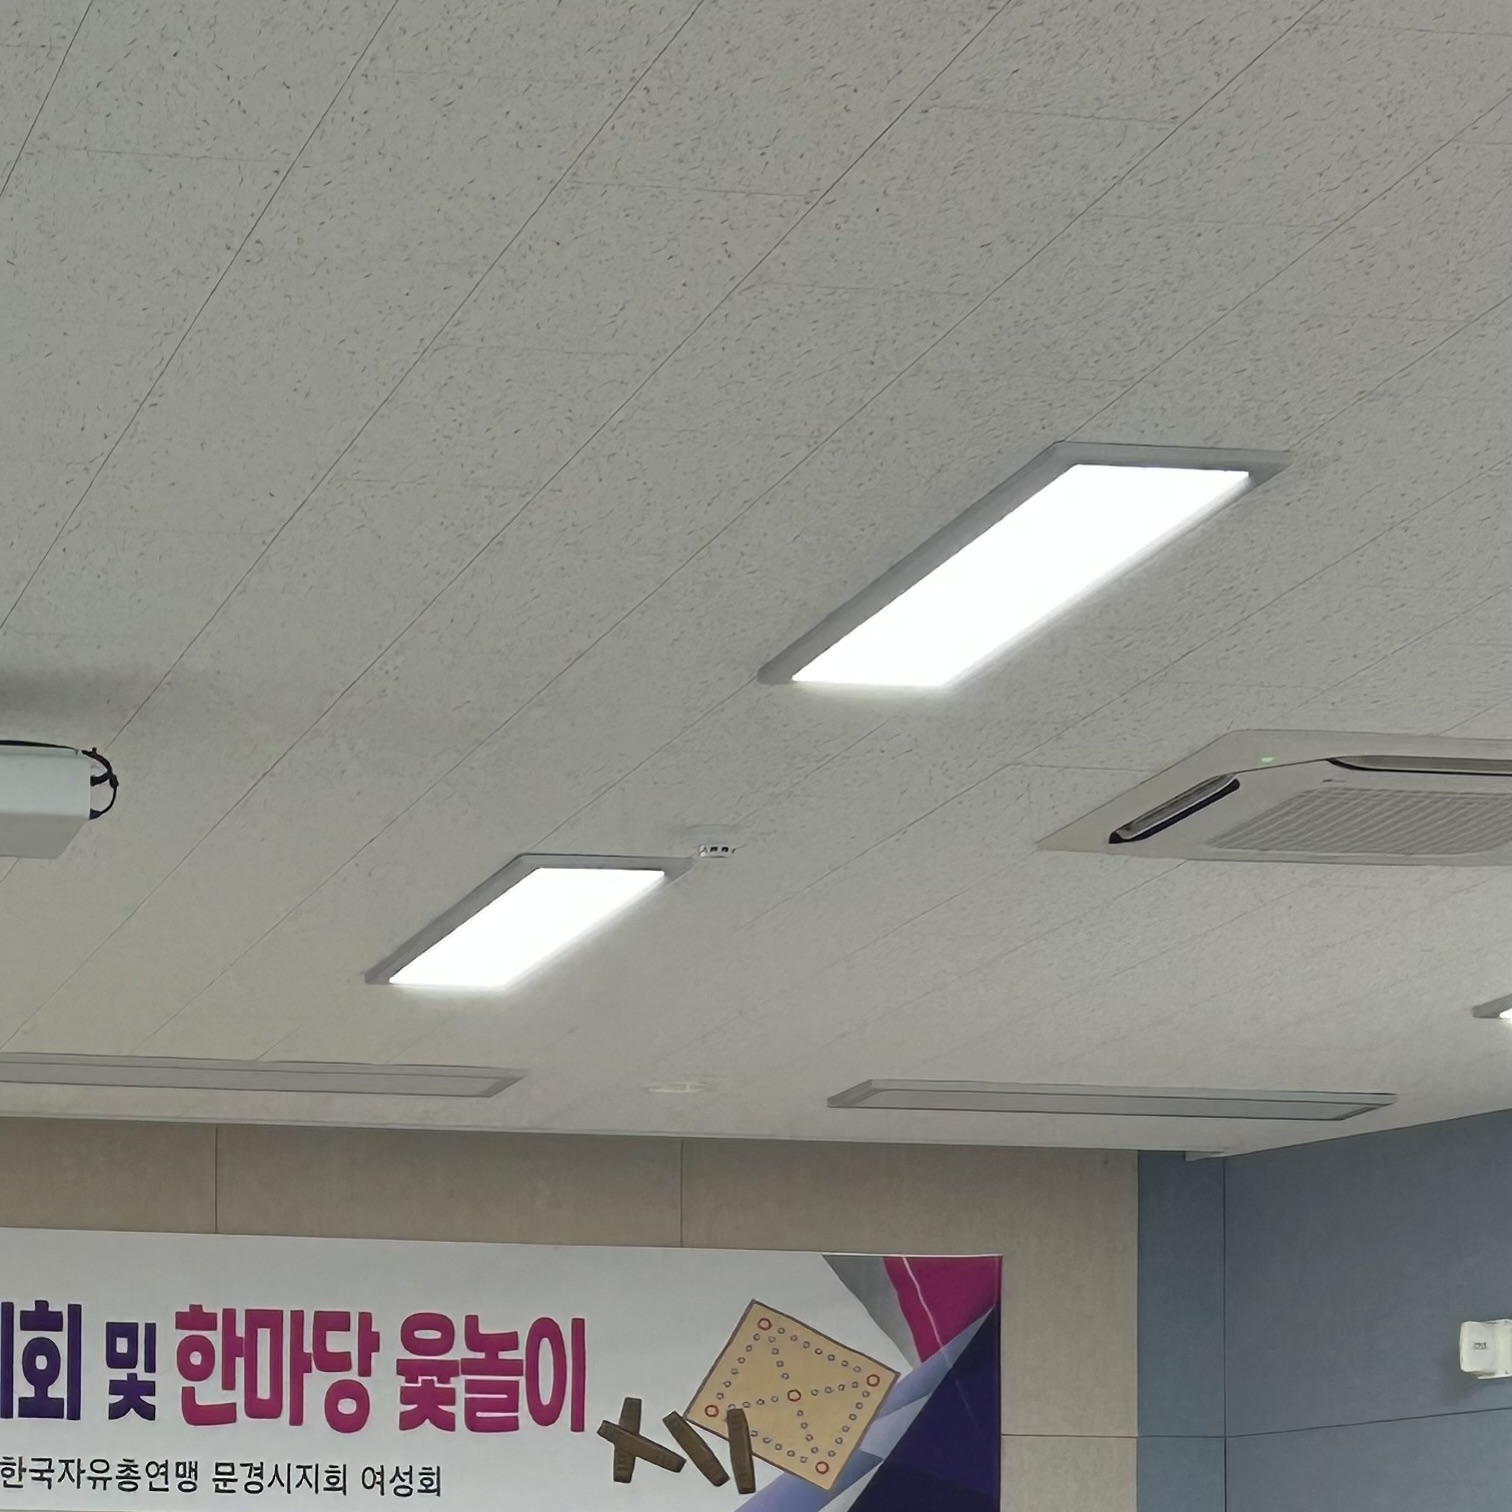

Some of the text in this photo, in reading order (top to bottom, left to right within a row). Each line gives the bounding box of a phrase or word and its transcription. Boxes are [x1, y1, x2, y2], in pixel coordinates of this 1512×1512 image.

[106, 1322, 156, 1421] 및
[175, 1304, 380, 1433] 한마당
[396, 1313, 586, 1433] 윷놀이
[0, 1457, 440, 1497] 한국자유총연맹 문경시지회 여성회
